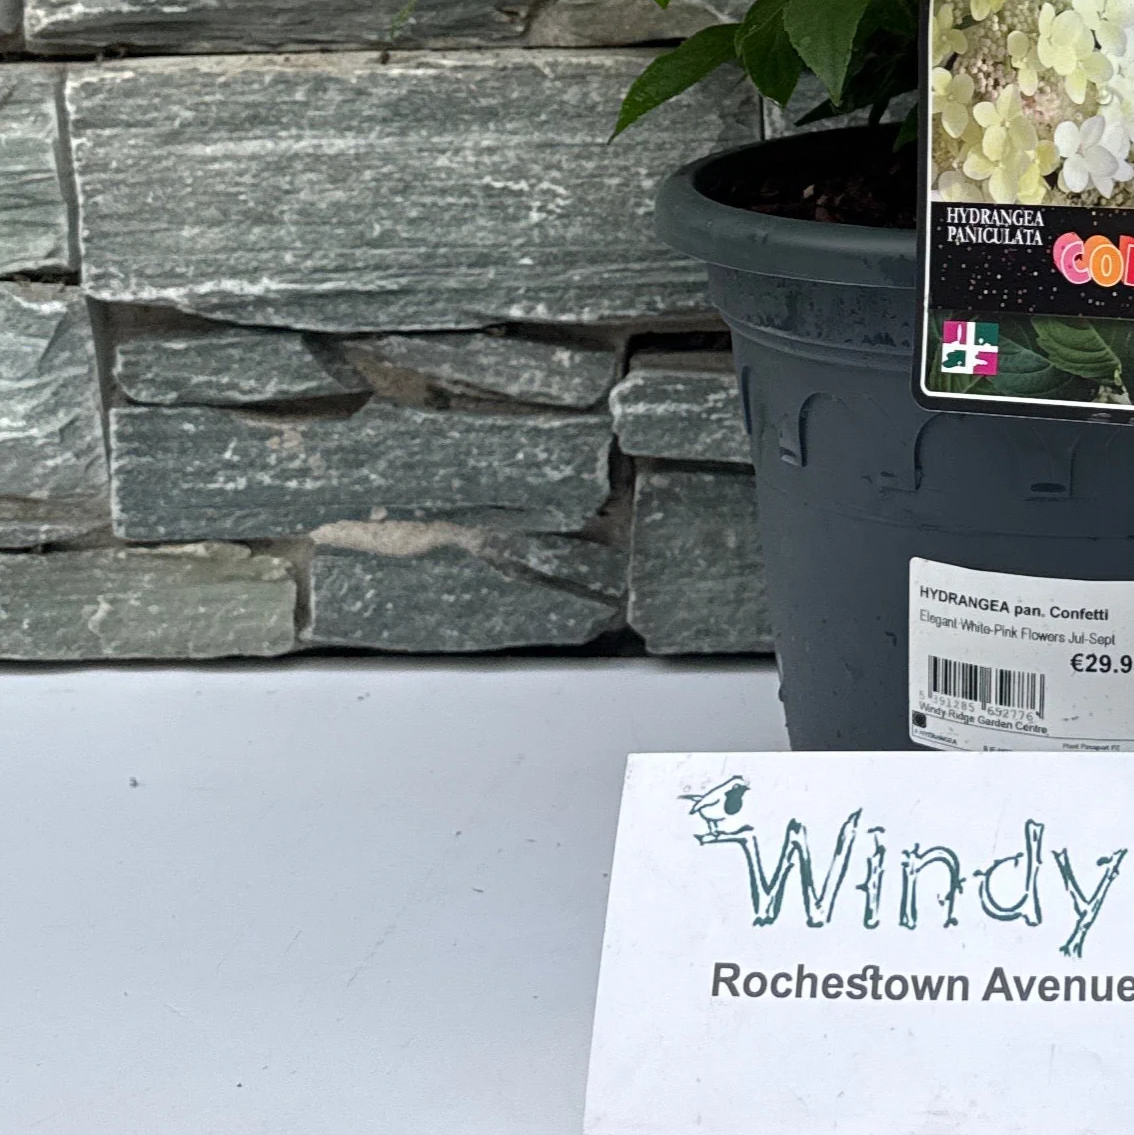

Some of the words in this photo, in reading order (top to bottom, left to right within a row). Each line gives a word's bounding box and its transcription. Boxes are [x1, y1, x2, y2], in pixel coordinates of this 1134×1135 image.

[946, 207, 1045, 228] HYDRANGEA
[947, 225, 1044, 247] PANICULATA
[919, 585, 1011, 614] HYDRANGEA
[1014, 605, 1046, 618] pan.
[1049, 605, 1109, 621] Confetti
[919, 609, 958, 628] Elegant
[960, 617, 1018, 639] White-Pink
[1020, 626, 1066, 644] Flowers
[1068, 631, 1116, 647] Jul-Sept
[918, 700, 946, 718] Windy
[947, 709, 975, 725] Ridge
[977, 715, 1013, 730] Garden
[1014, 720, 1048, 734] Centre
[711, 962, 970, 1001] Rochestown
